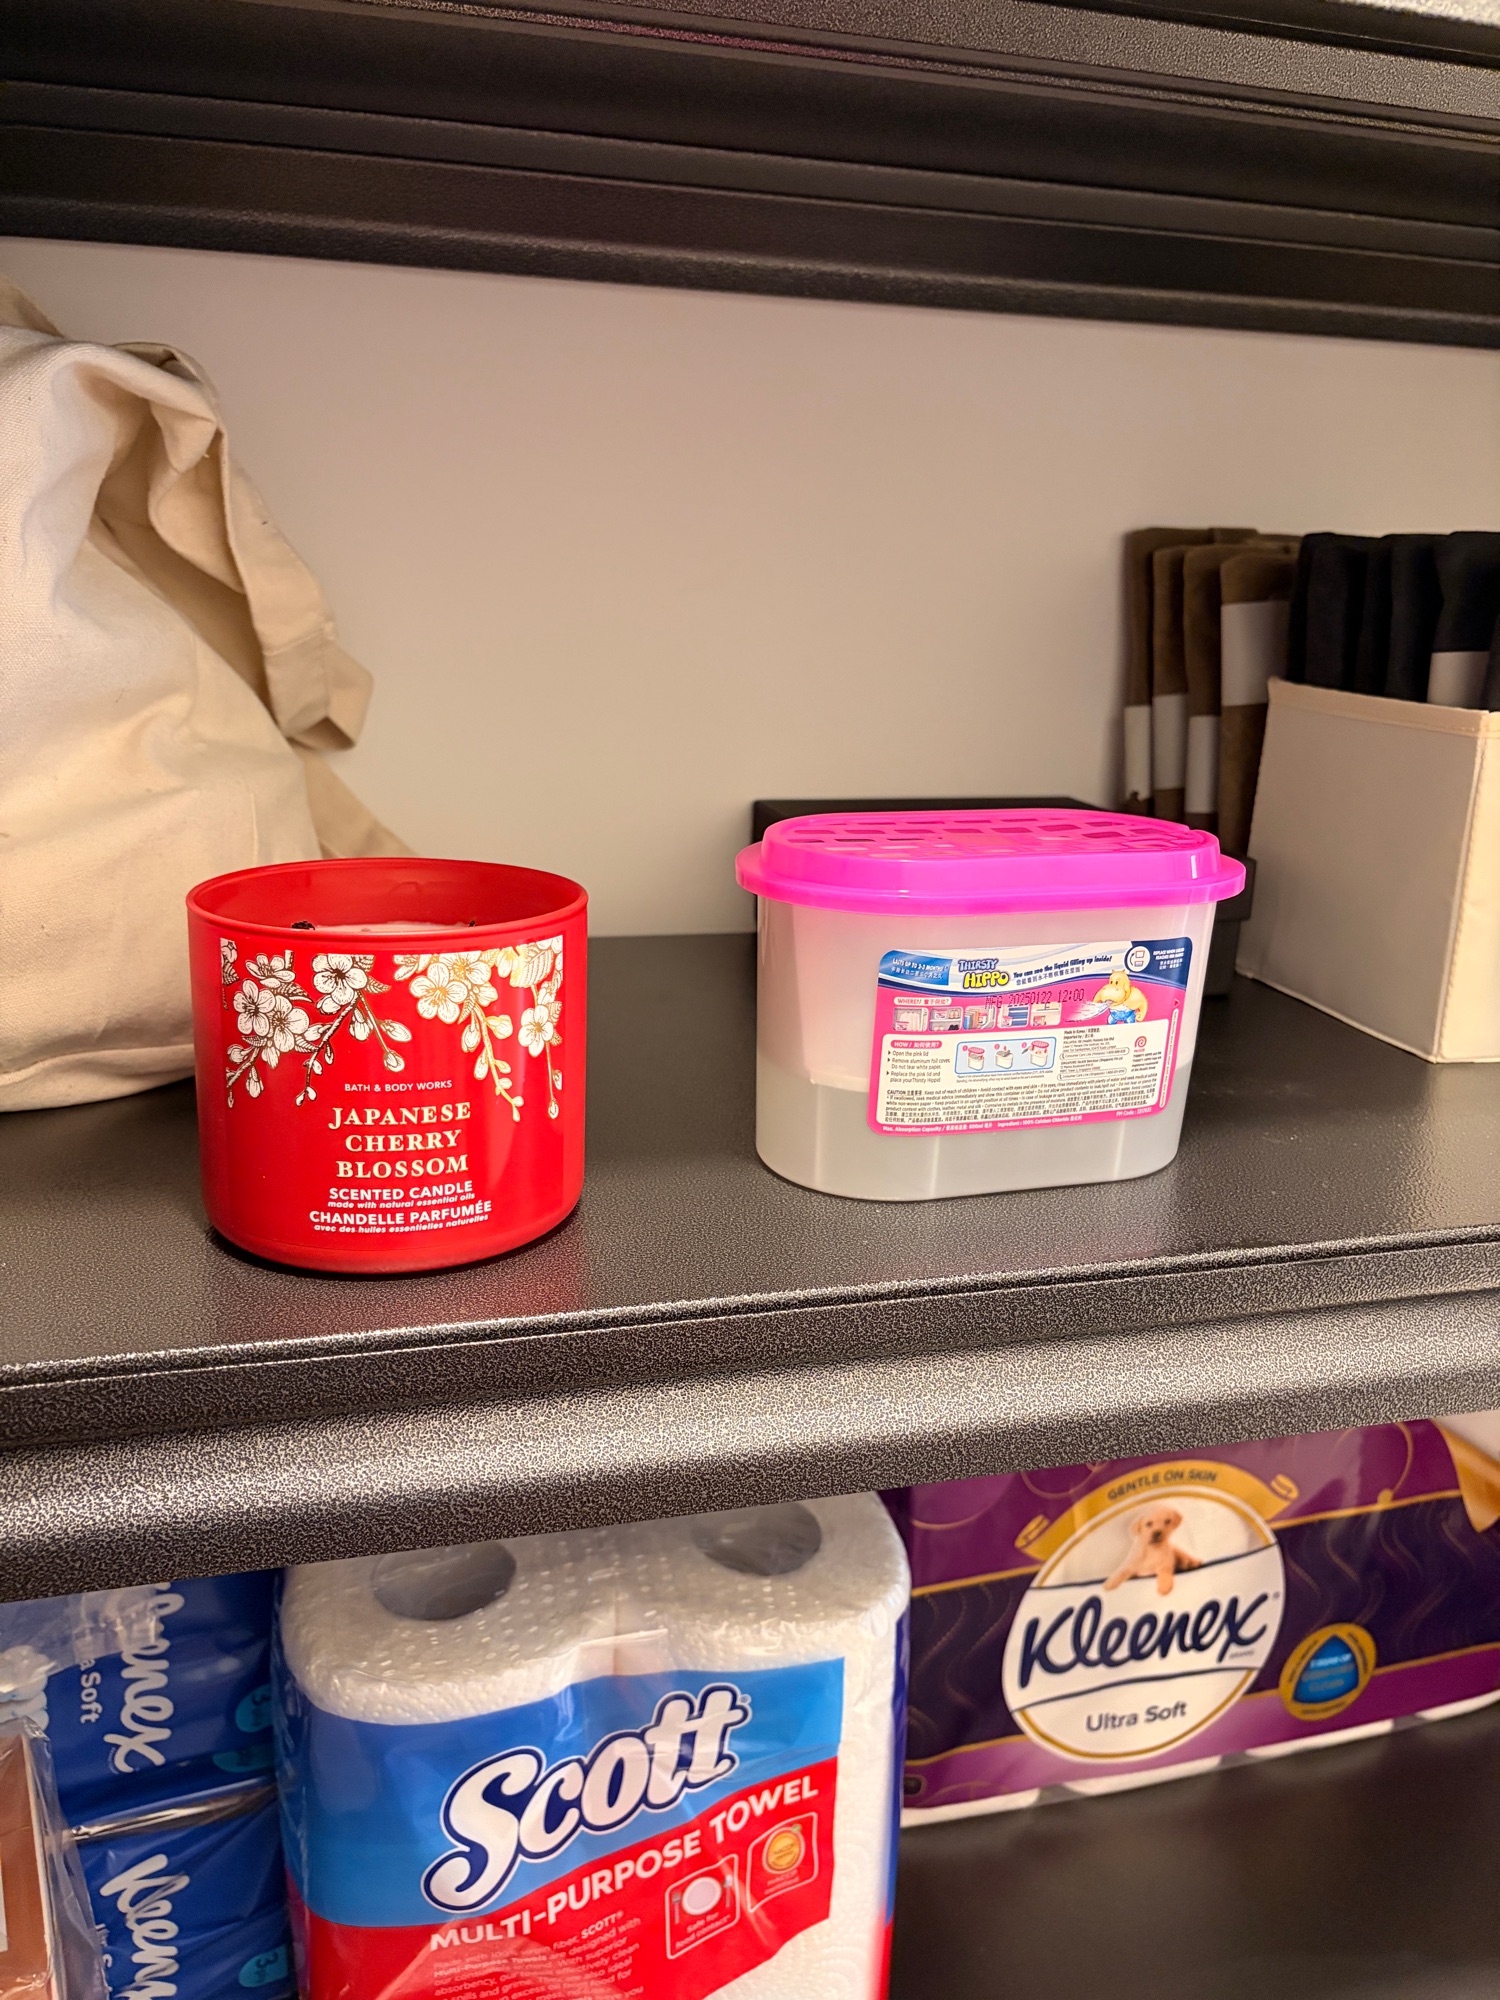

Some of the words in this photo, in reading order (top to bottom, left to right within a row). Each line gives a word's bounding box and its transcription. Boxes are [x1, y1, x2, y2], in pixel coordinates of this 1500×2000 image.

[958, 958, 999, 972] THIRSTY
[1054, 960, 1069, 971] liquid
[1070, 958, 1085, 967] filling
[1086, 957, 1093, 965] up
[1094, 955, 1113, 963] inside!
[963, 970, 1010, 989] HIPPO
[985, 995, 1003, 1010] MFG
[1008, 990, 1052, 1007] 20250122
[1058, 988, 1085, 1003] 12:00
[344, 1083, 371, 1092] BATH
[373, 1083, 382, 1092] &
[384, 1082, 414, 1092] BODY
[416, 1080, 453, 1092] WORKS
[327, 1101, 471, 1130] JAPANESE
[344, 1129, 462, 1152] CHERRY
[335, 1154, 469, 1179] BLOSSOM
[327, 1201, 355, 1209] made
[357, 1201, 377, 1209] with
[379, 1200, 415, 1209] natural
[416, 1195, 458, 1207] essential
[459, 1193, 476, 1201] oils
[329, 1188, 405, 1201] SCENTED
[409, 1180, 473, 1199] CANDLE
[309, 1210, 405, 1226] CHANDELLE
[409, 1199, 493, 1224] PARFUMÉE
[339, 1225, 356, 1233] des
[358, 1225, 387, 1234] huiles
[388, 1222, 444, 1233] essentielles
[445, 1213, 489, 1228] naturelles
[1106, 1473, 1160, 1502] GENTLE
[1164, 1470, 1185, 1484] ON
[1187, 1468, 1219, 1483] SKIN
[1018, 1592, 1269, 1690] Kleenex
[80, 1671, 103, 1723] Soft
[1085, 1713, 1138, 1734] Ultra
[1144, 1700, 1188, 1726] Soft
[420, 1681, 750, 1914] Scott
[429, 1829, 702, 1953] MULTI-PURPOSE
[708, 1775, 819, 1845] TOWEL
[568, 1926, 617, 1956] designed
[617, 1917, 642, 1934] with
[585, 1936, 628, 1961] superior
[676, 1932, 697, 1949] food
[499, 1973, 519, 1983] our
[611, 1942, 641, 1962] clean
[617, 1968, 633, 1981] for
[479, 1986, 501, 1998] and
[607, 1955, 633, 1974] ideal
